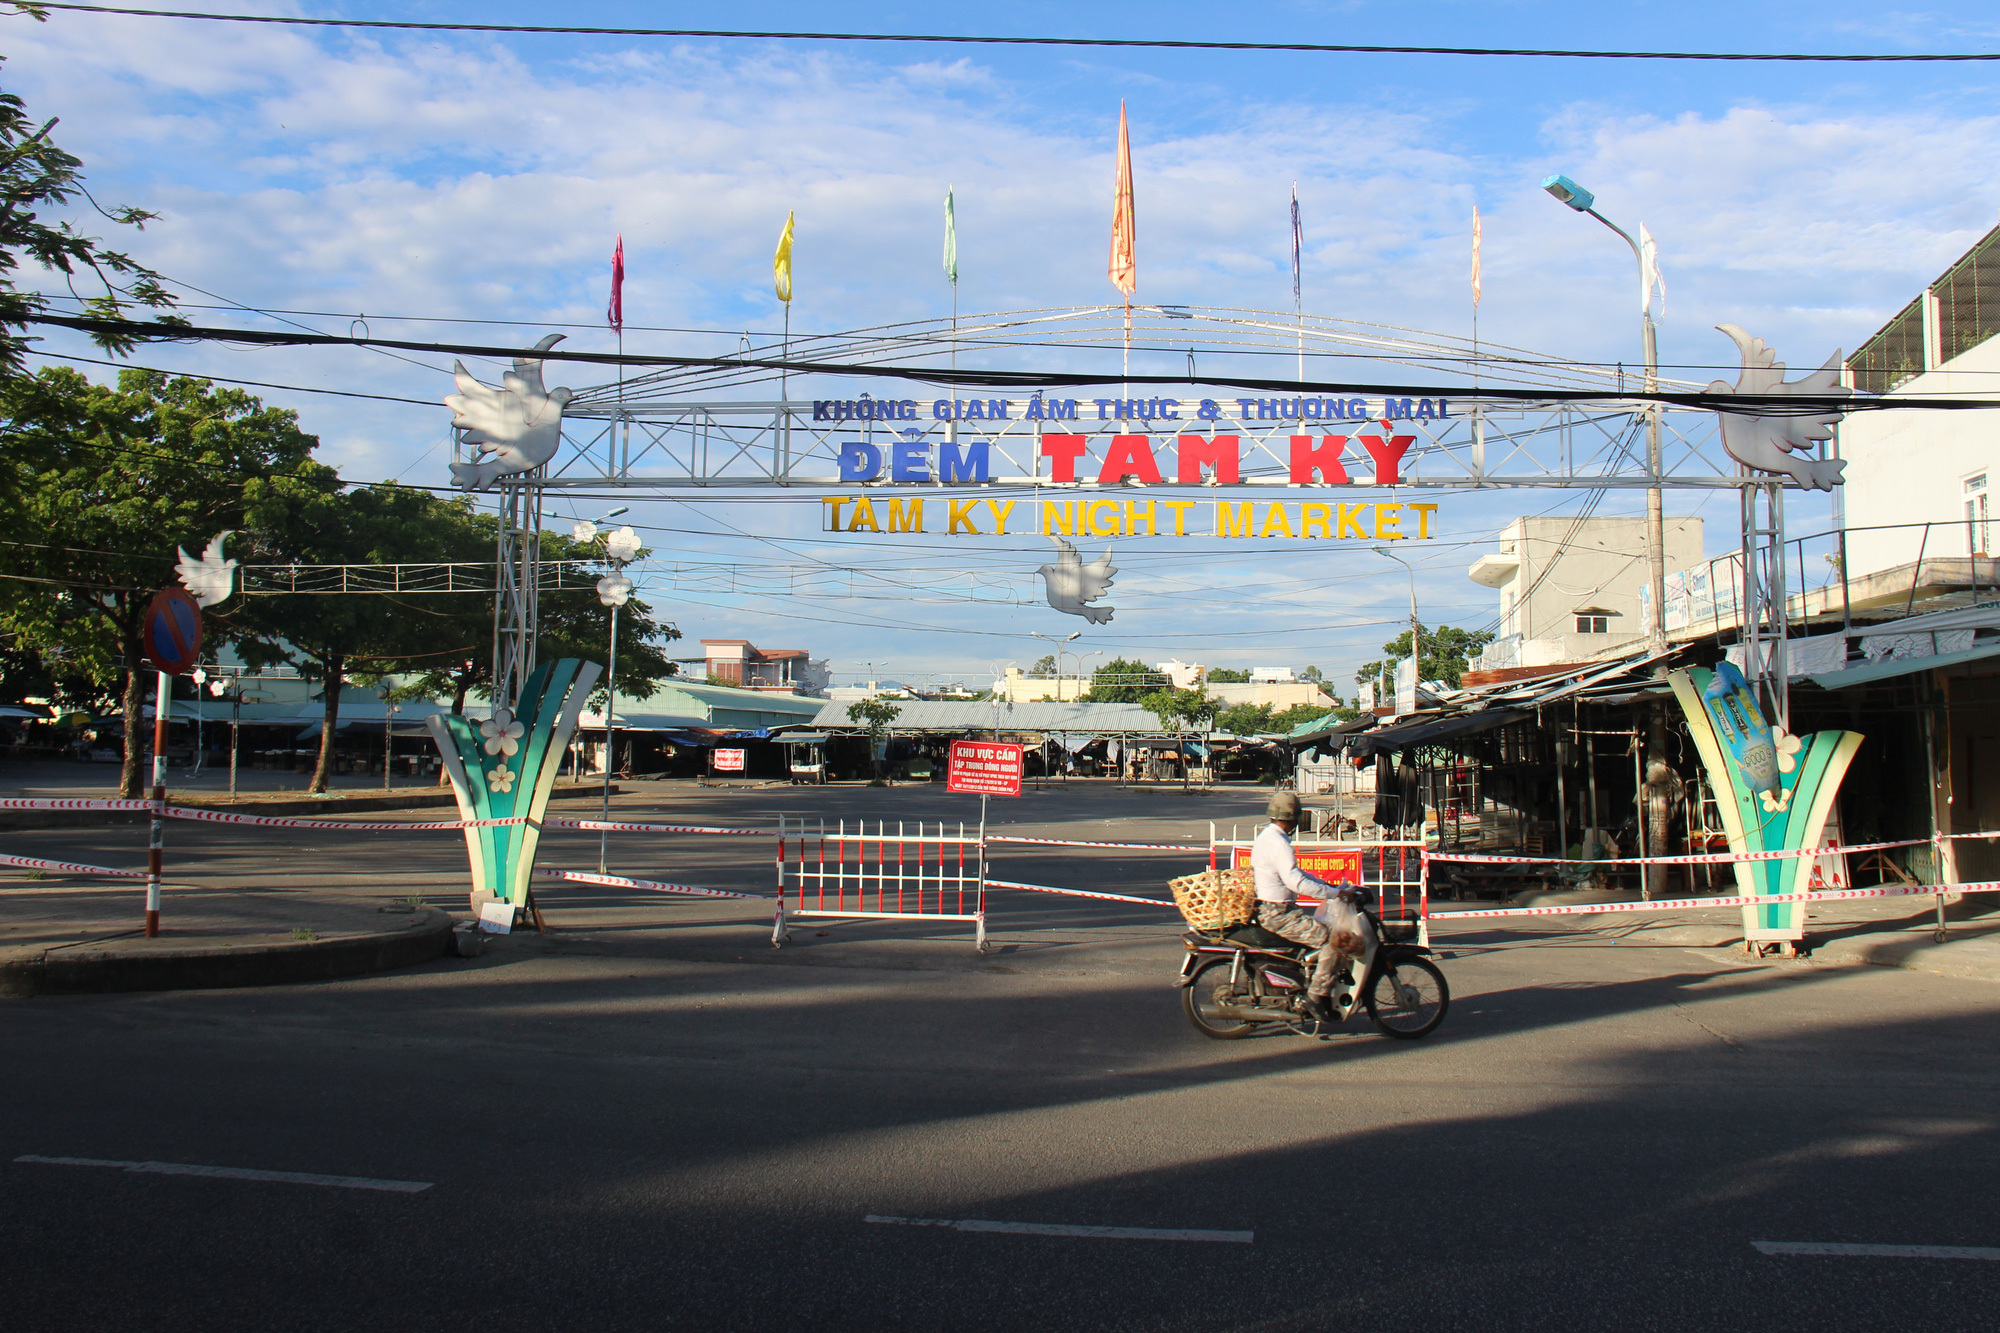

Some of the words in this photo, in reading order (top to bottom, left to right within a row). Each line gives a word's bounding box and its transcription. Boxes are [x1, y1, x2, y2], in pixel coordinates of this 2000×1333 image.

[813, 392, 917, 421] KHÔNG
[933, 399, 1008, 420] GIAN
[1026, 389, 1076, 420] ẨM
[1094, 396, 1179, 426] THỰC
[1198, 399, 1220, 419] &
[1238, 395, 1367, 420] THƯƠNG
[1385, 398, 1448, 427] MẠI
[837, 427, 990, 482] ĐÊM
[1041, 434, 1239, 483] TAM
[1289, 420, 1418, 484] KỲ
[821, 496, 924, 532] TAM
[949, 499, 1017, 535] KY
[1043, 500, 1195, 537] NIGHT
[1217, 501, 1439, 540] MARKET
[954, 759, 965, 770] TẬP
[966, 761, 984, 770] TRUNG
[957, 747, 975, 758] KHU
[977, 748, 994, 761] VỰC
[997, 748, 1017, 761] CẤM
[1301, 858, 1314, 871] DỊCH
[1314, 856, 1329, 873] BỆNH
[1329, 858, 1345, 871] COVID
[1348, 859, 1356, 871] 19
